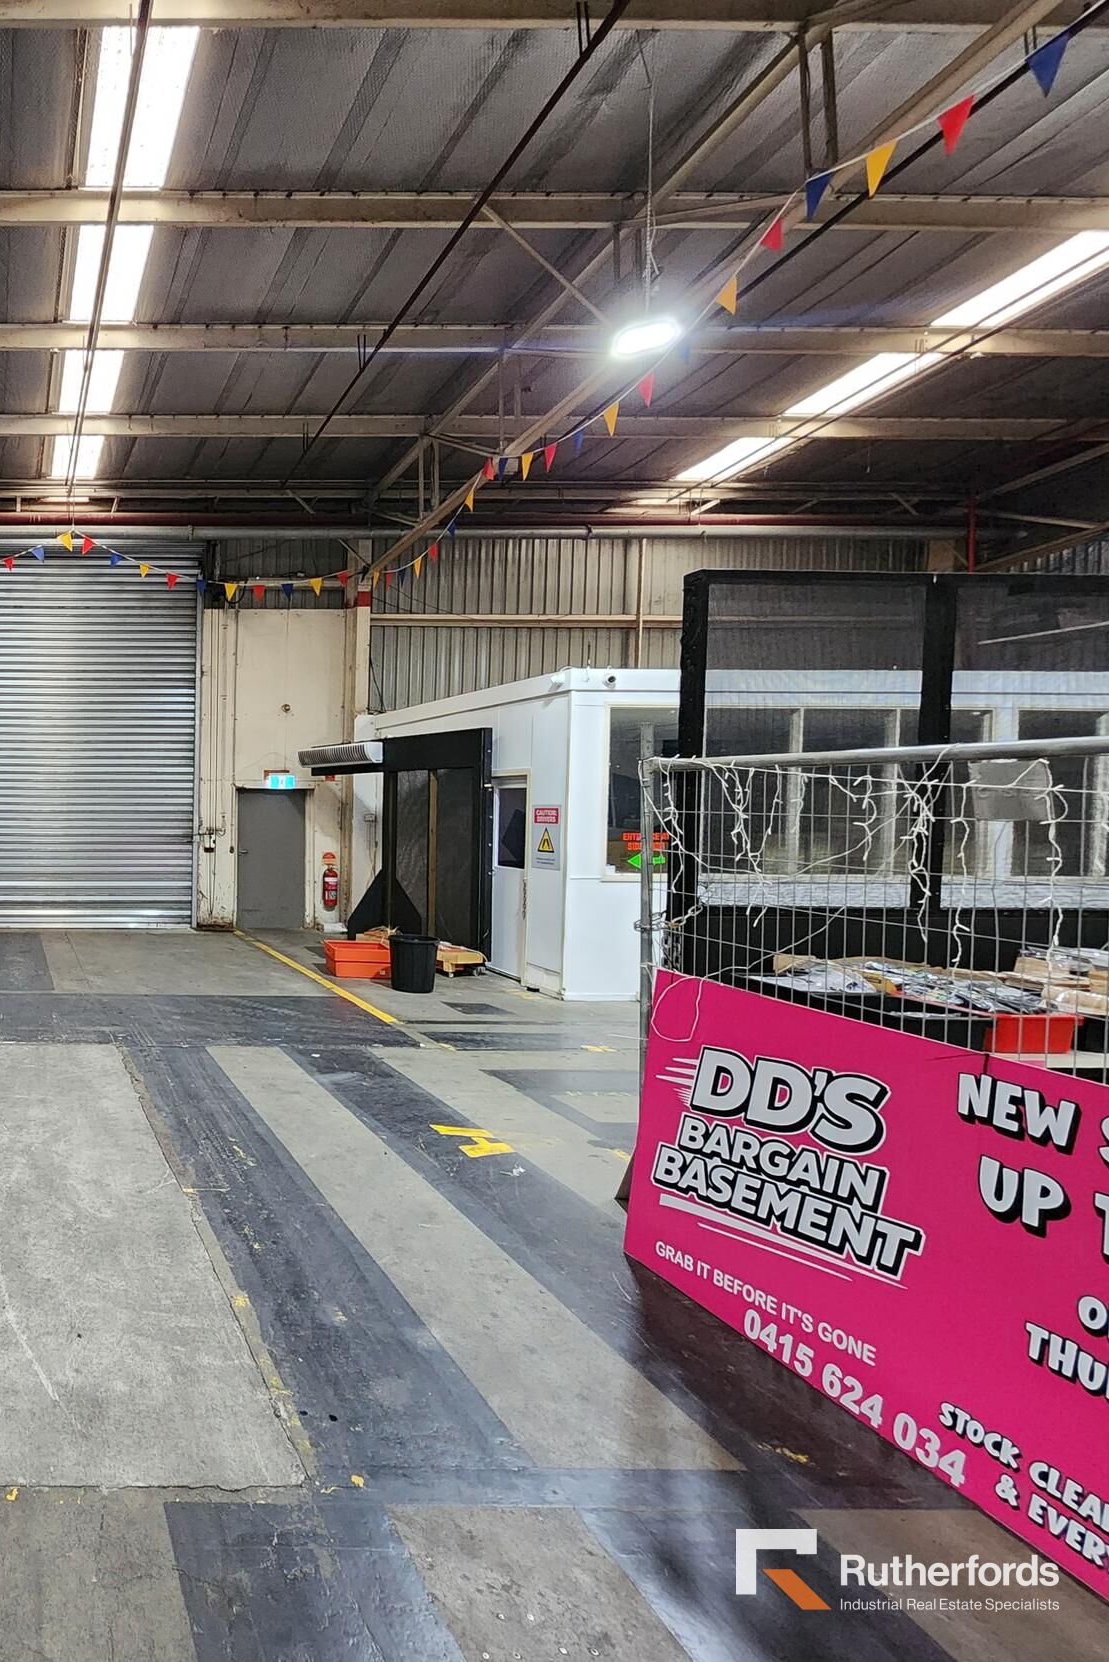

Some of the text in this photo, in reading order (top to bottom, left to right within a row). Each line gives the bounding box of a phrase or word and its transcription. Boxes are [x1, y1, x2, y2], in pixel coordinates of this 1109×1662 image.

[691, 1047, 888, 1152] DD'S
[957, 1072, 1078, 1150] NEW
[678, 1114, 889, 1212] BARGAIN
[979, 1155, 1069, 1231] UP
[654, 1145, 924, 1277] BASEMENT
[655, 1240, 877, 1367] GRAB IT BEFORE IT'S GONE
[1078, 1295, 1109, 1340] O
[744, 1309, 967, 1487] 0415 624 034
[1024, 1321, 1109, 1400] THU
[939, 1402, 1020, 1470] STOCK
[994, 1473, 1109, 1568] & EVER
